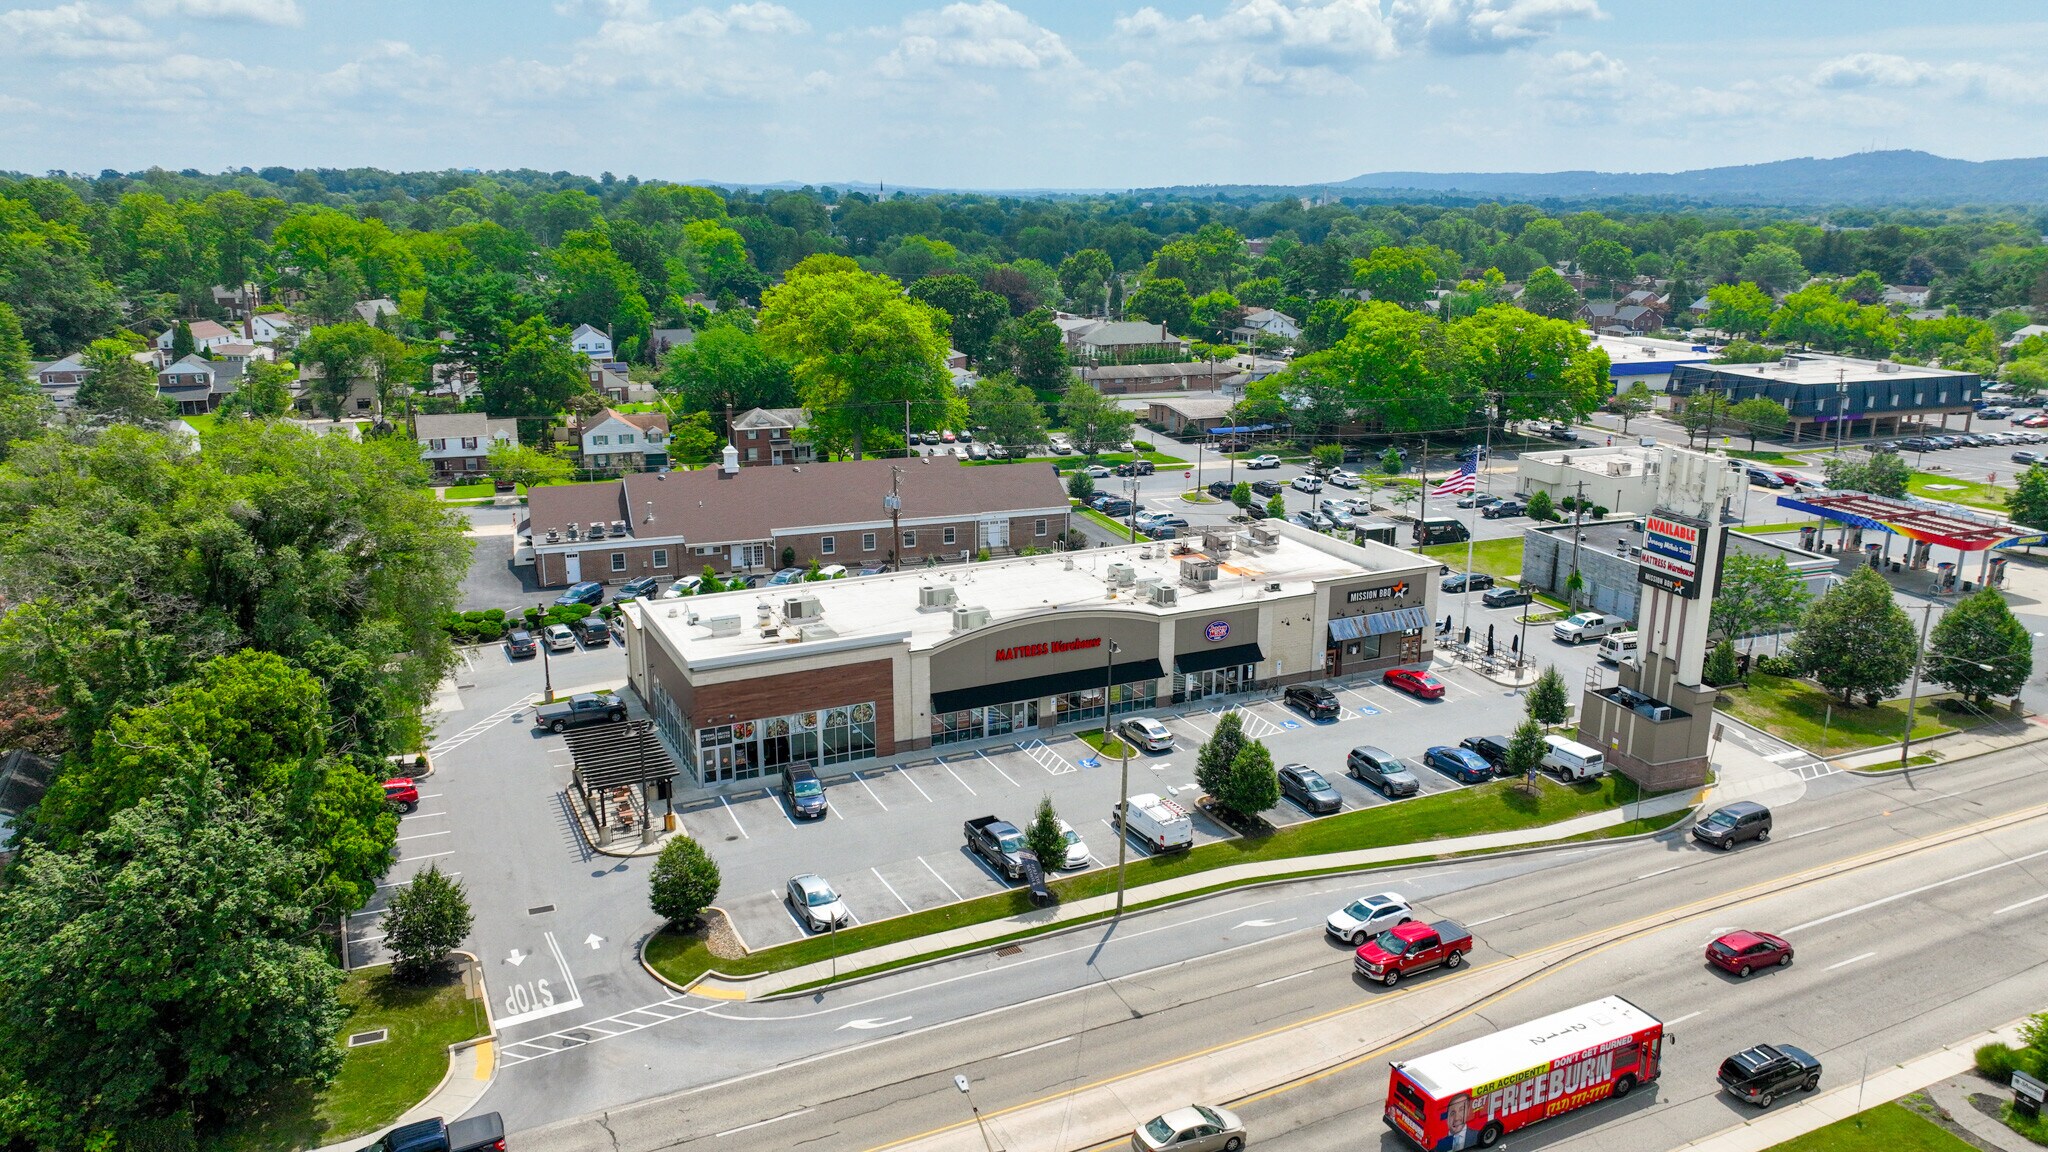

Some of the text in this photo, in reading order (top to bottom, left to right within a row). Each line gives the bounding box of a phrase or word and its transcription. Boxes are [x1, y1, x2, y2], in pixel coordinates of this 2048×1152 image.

[1647, 518, 1696, 541] AVAILABLE
[1642, 554, 1694, 577] MATTRESS Warehouse
[1645, 574, 1664, 584] MISSION
[1351, 590, 1378, 602] MISSION
[1380, 588, 1391, 598] BBQ
[995, 637, 1102, 662] MATTRESS Warehouse
[505, 978, 555, 1015] STOP
[1529, 1023, 1587, 1046] 2112
[1553, 1035, 1633, 1069] DON'T GET BURNED
[1471, 1051, 1614, 1122] GET FREEBURN
[1476, 1064, 1547, 1095] CAR ACCIDENT?
[1546, 1083, 1611, 1116] (717) 777-7777
